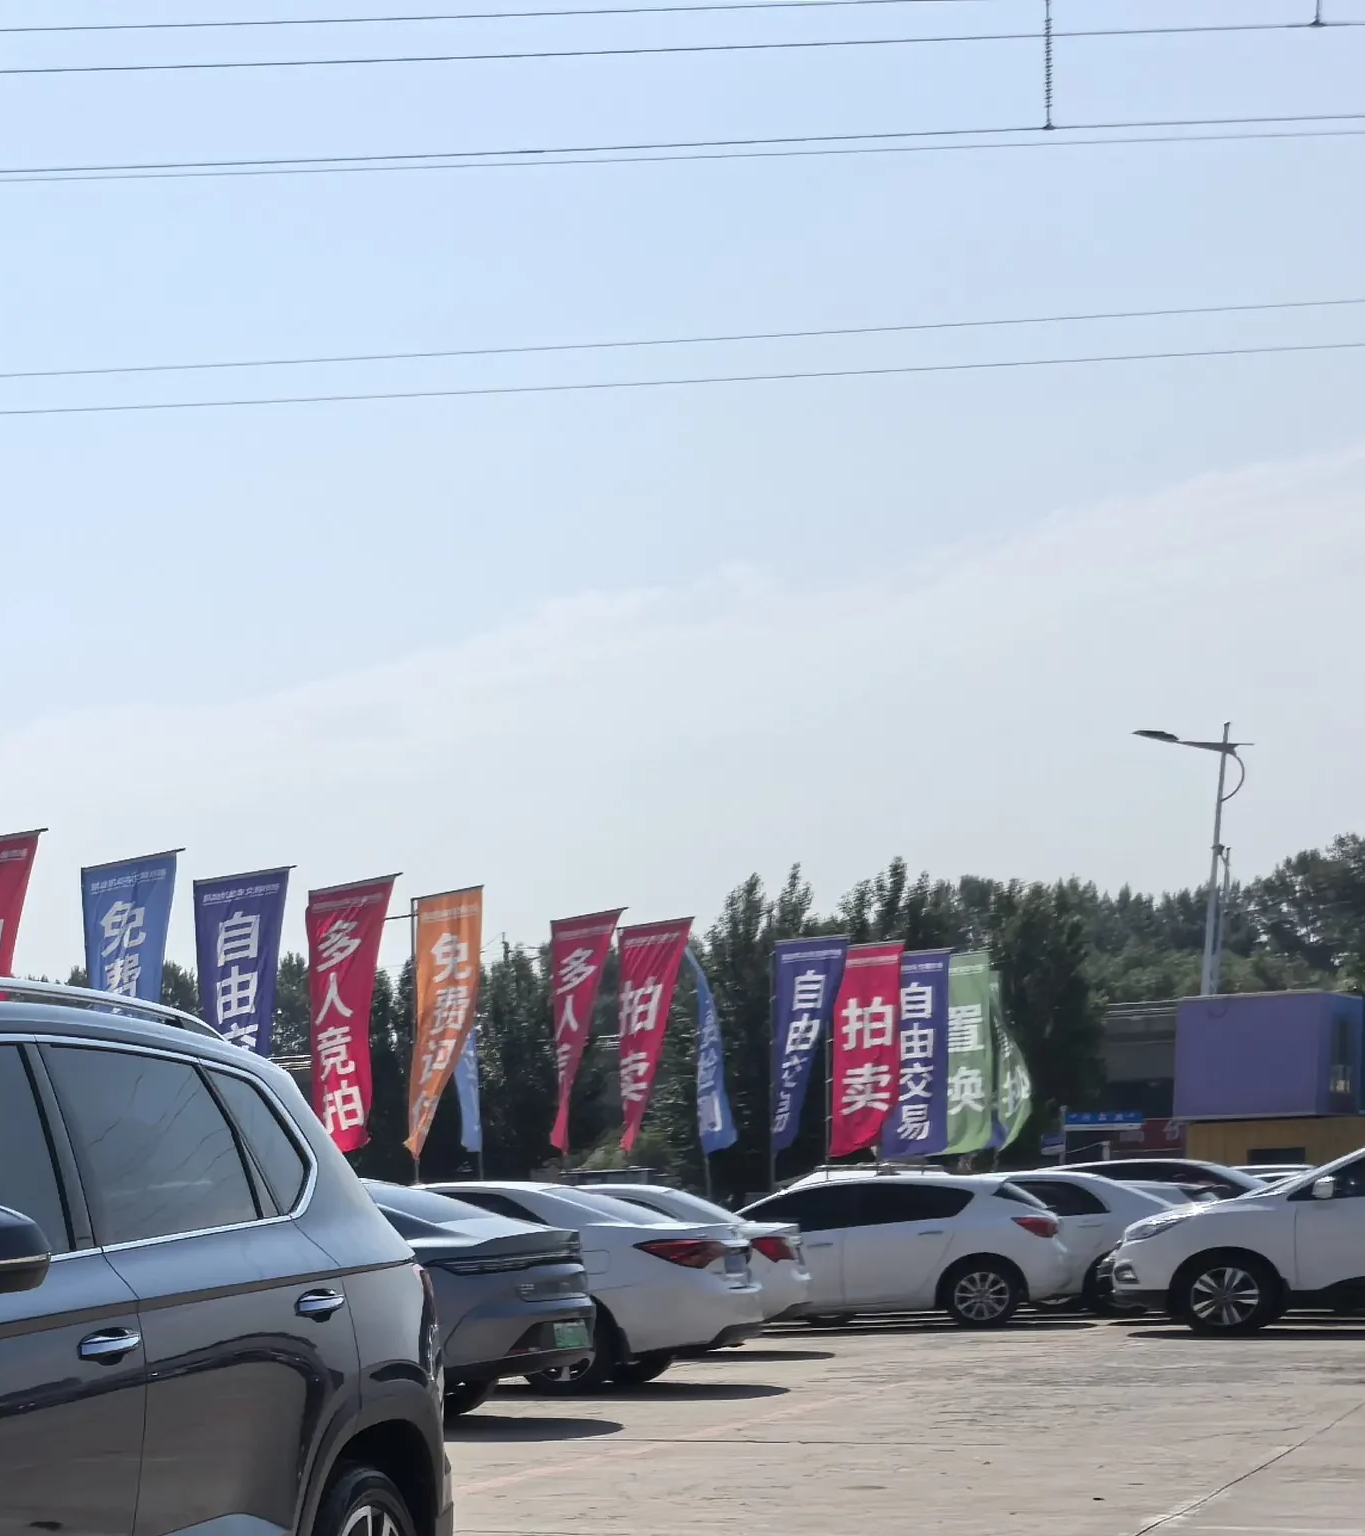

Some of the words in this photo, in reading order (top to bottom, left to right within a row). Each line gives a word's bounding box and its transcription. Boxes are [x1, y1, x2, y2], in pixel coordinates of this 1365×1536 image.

[100, 900, 146, 998] 免费
[315, 919, 365, 1135] 多人竞拍
[772, 970, 826, 1134] 自由交易
[841, 996, 894, 1116] 拍卖
[897, 982, 933, 1140] 自由交易
[947, 1003, 985, 1115] 置换
